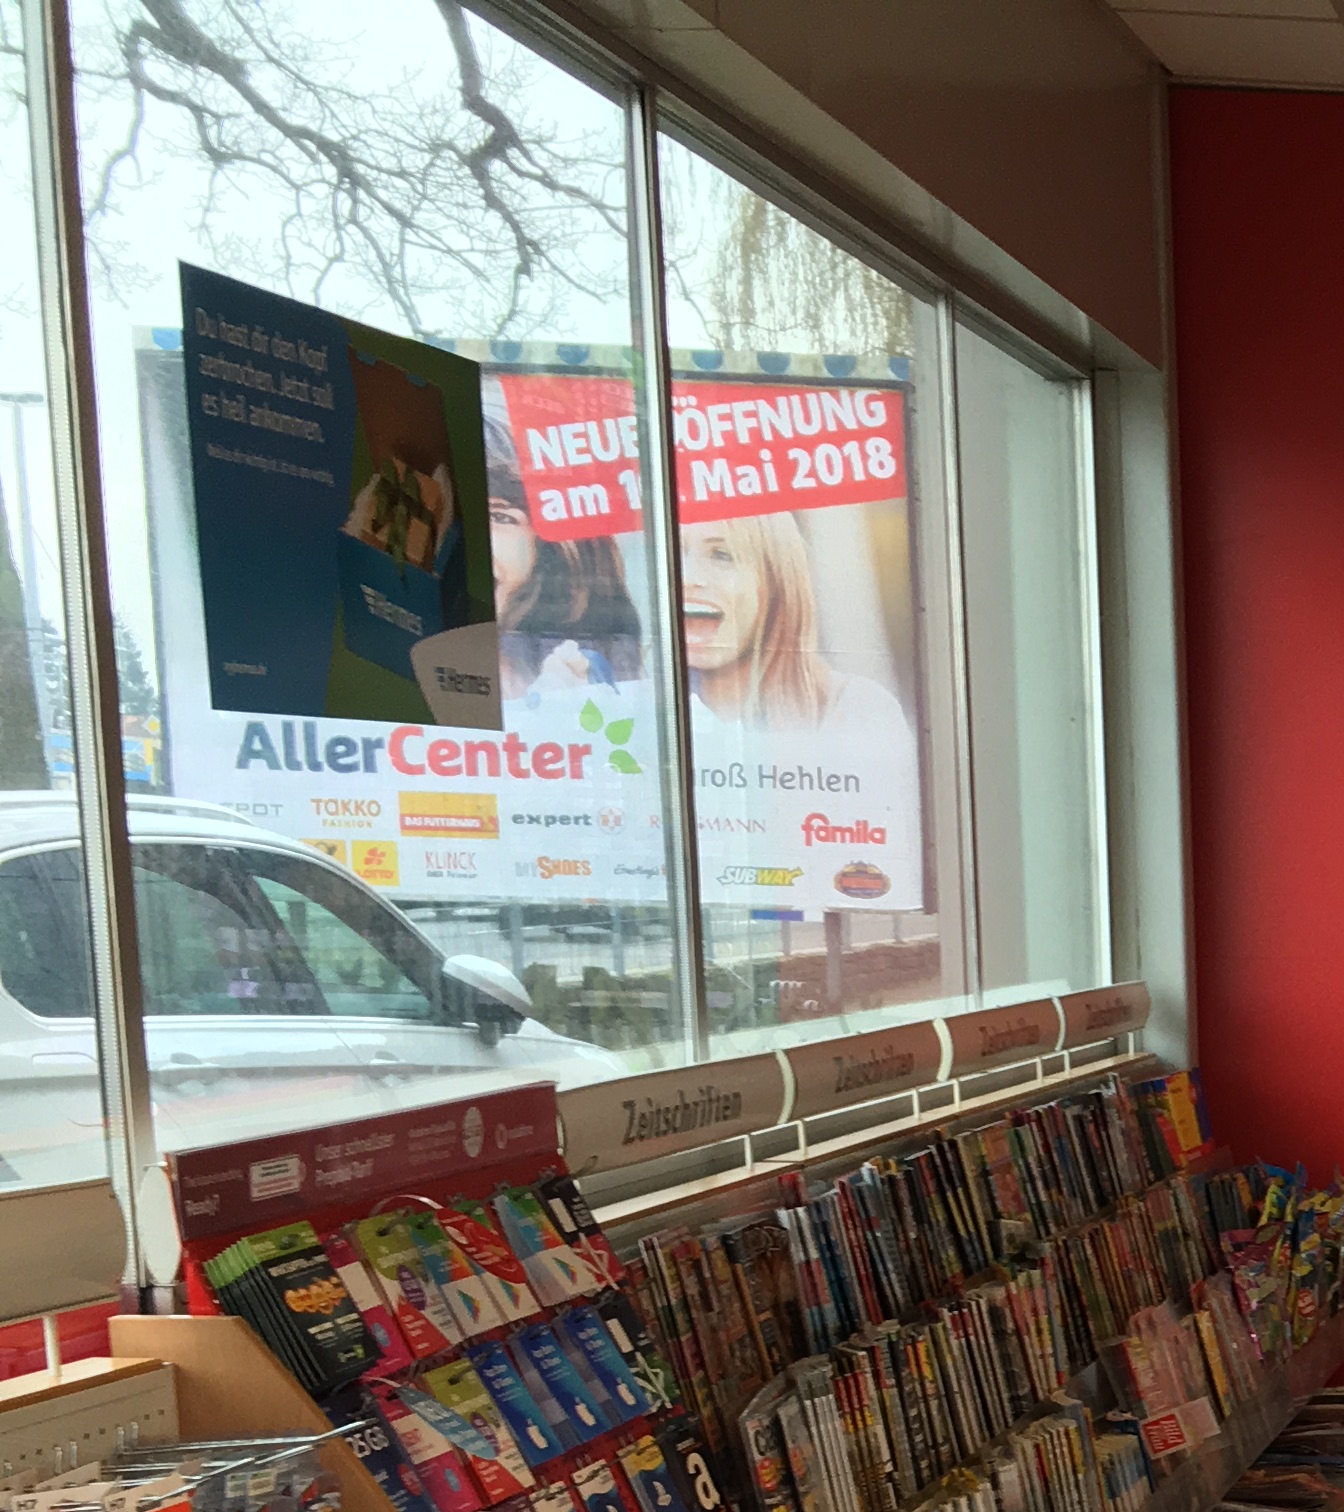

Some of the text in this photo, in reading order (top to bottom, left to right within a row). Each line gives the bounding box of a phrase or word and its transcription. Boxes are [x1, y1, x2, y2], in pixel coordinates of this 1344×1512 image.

[525, 388, 888, 471] NEUEÖFFNUNG
[538, 479, 609, 521] am
[690, 448, 779, 501] Mai
[787, 437, 897, 489] 2018
[235, 720, 593, 780] AllerCenter
[700, 762, 861, 793] roß Hehlen
[512, 812, 593, 829] expert
[801, 812, 887, 846] famila
[537, 855, 592, 879] SHOES
[718, 865, 805, 887] SUBWAY
[832, 1050, 915, 1094] Zeitschriften
[620, 1085, 743, 1146] Zeitschriften
